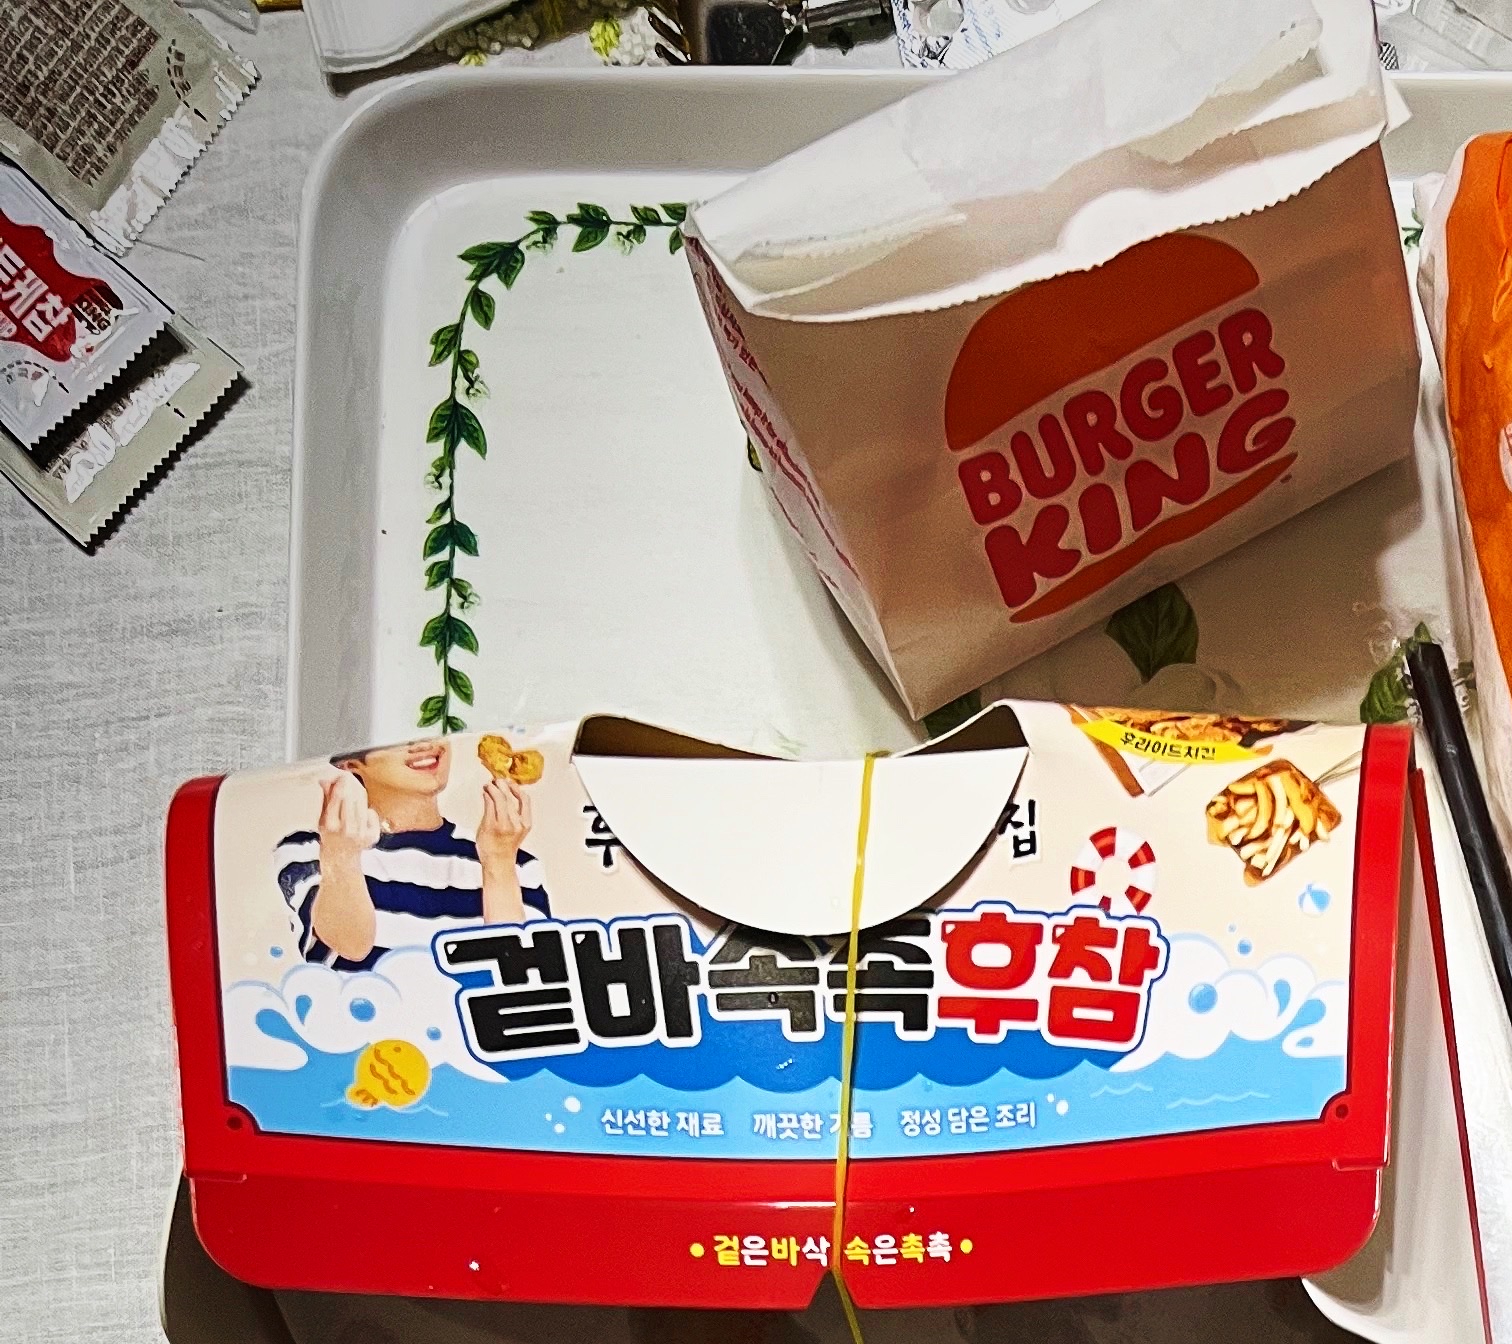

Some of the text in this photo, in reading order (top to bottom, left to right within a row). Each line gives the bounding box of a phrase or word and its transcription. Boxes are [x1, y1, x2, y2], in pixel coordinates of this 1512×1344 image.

[957, 306, 1286, 526] BURGER
[984, 388, 1297, 608] KING
[1120, 731, 1217, 761] 후라이드치킨
[601, 1109, 671, 1139] 신선한
[676, 1110, 725, 1138] 재료
[753, 1111, 825, 1140] 깨끗한
[899, 1107, 943, 1137] 정성
[946, 1106, 990, 1133] 담은
[994, 1101, 1038, 1129] 조리
[712, 1230, 953, 1267] 겉은바삭 속은촉촉
